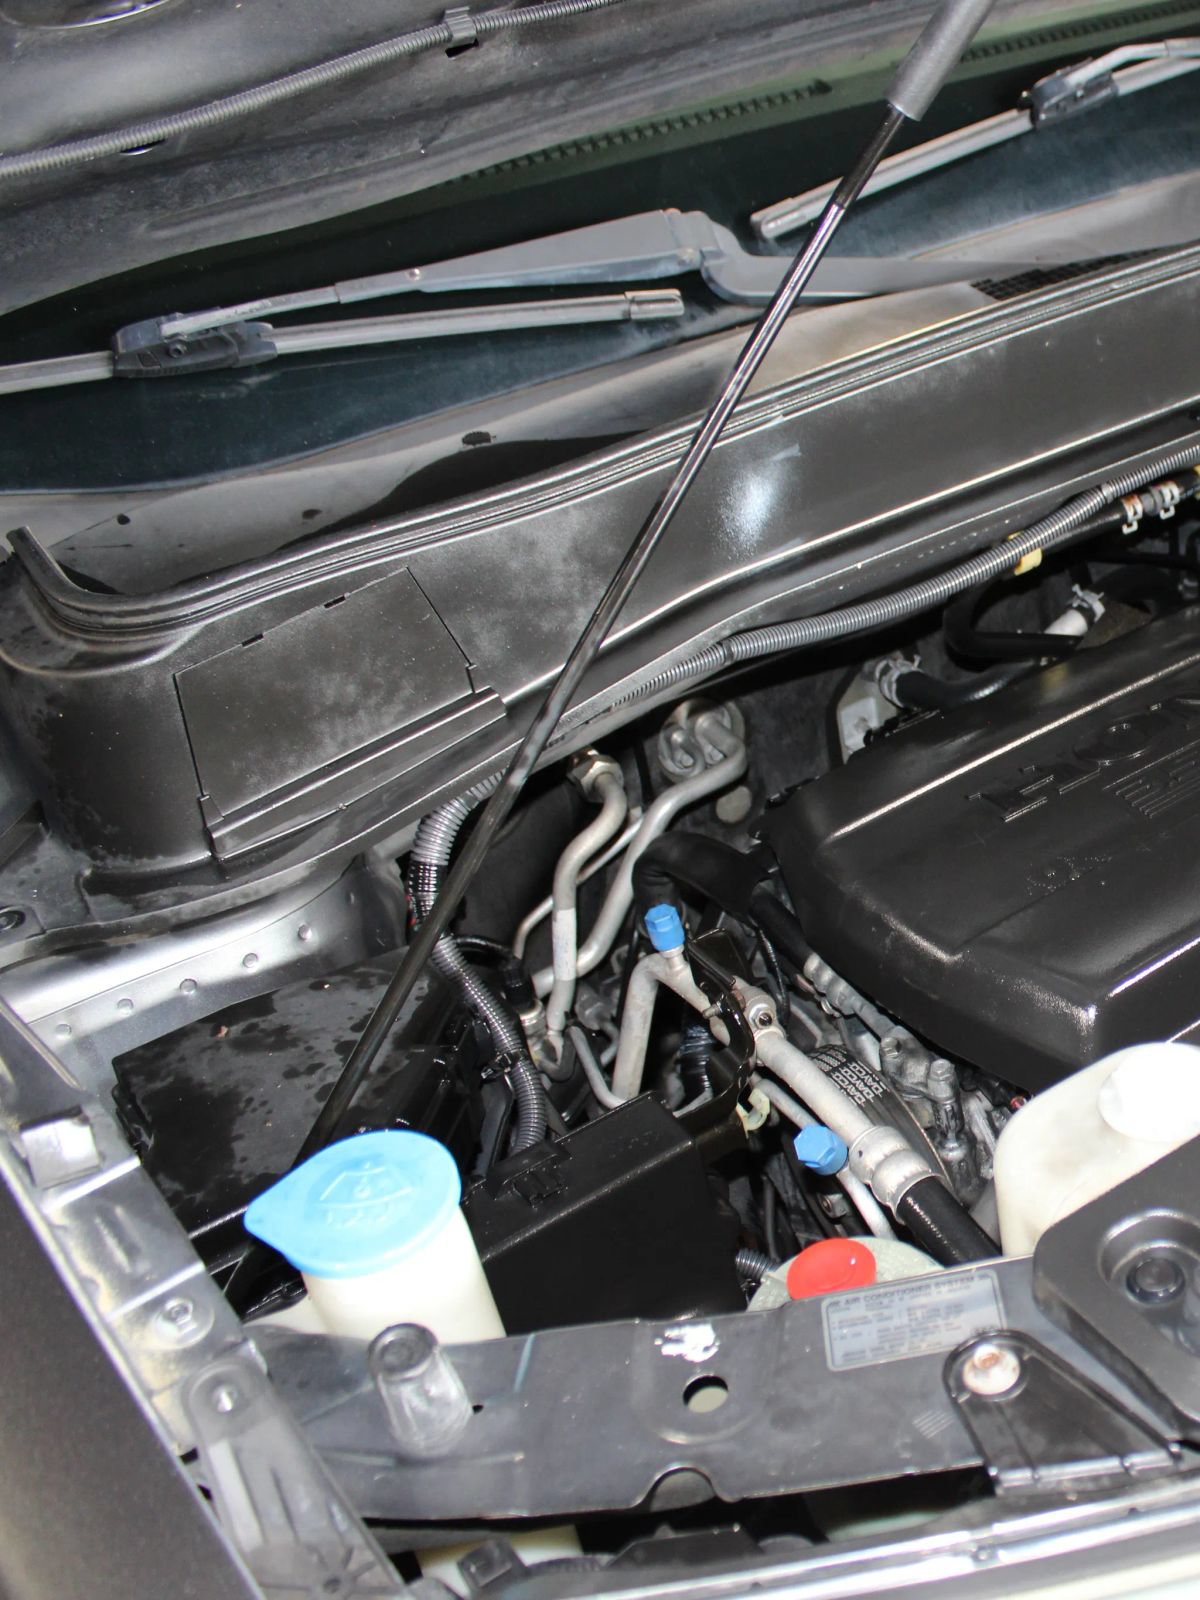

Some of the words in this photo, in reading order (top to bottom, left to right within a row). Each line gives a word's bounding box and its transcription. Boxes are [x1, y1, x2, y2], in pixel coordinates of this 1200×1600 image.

[831, 1072, 867, 1106] DAYCO
[839, 1067, 875, 1100] DAYCO
[848, 1061, 883, 1095] DAYCO
